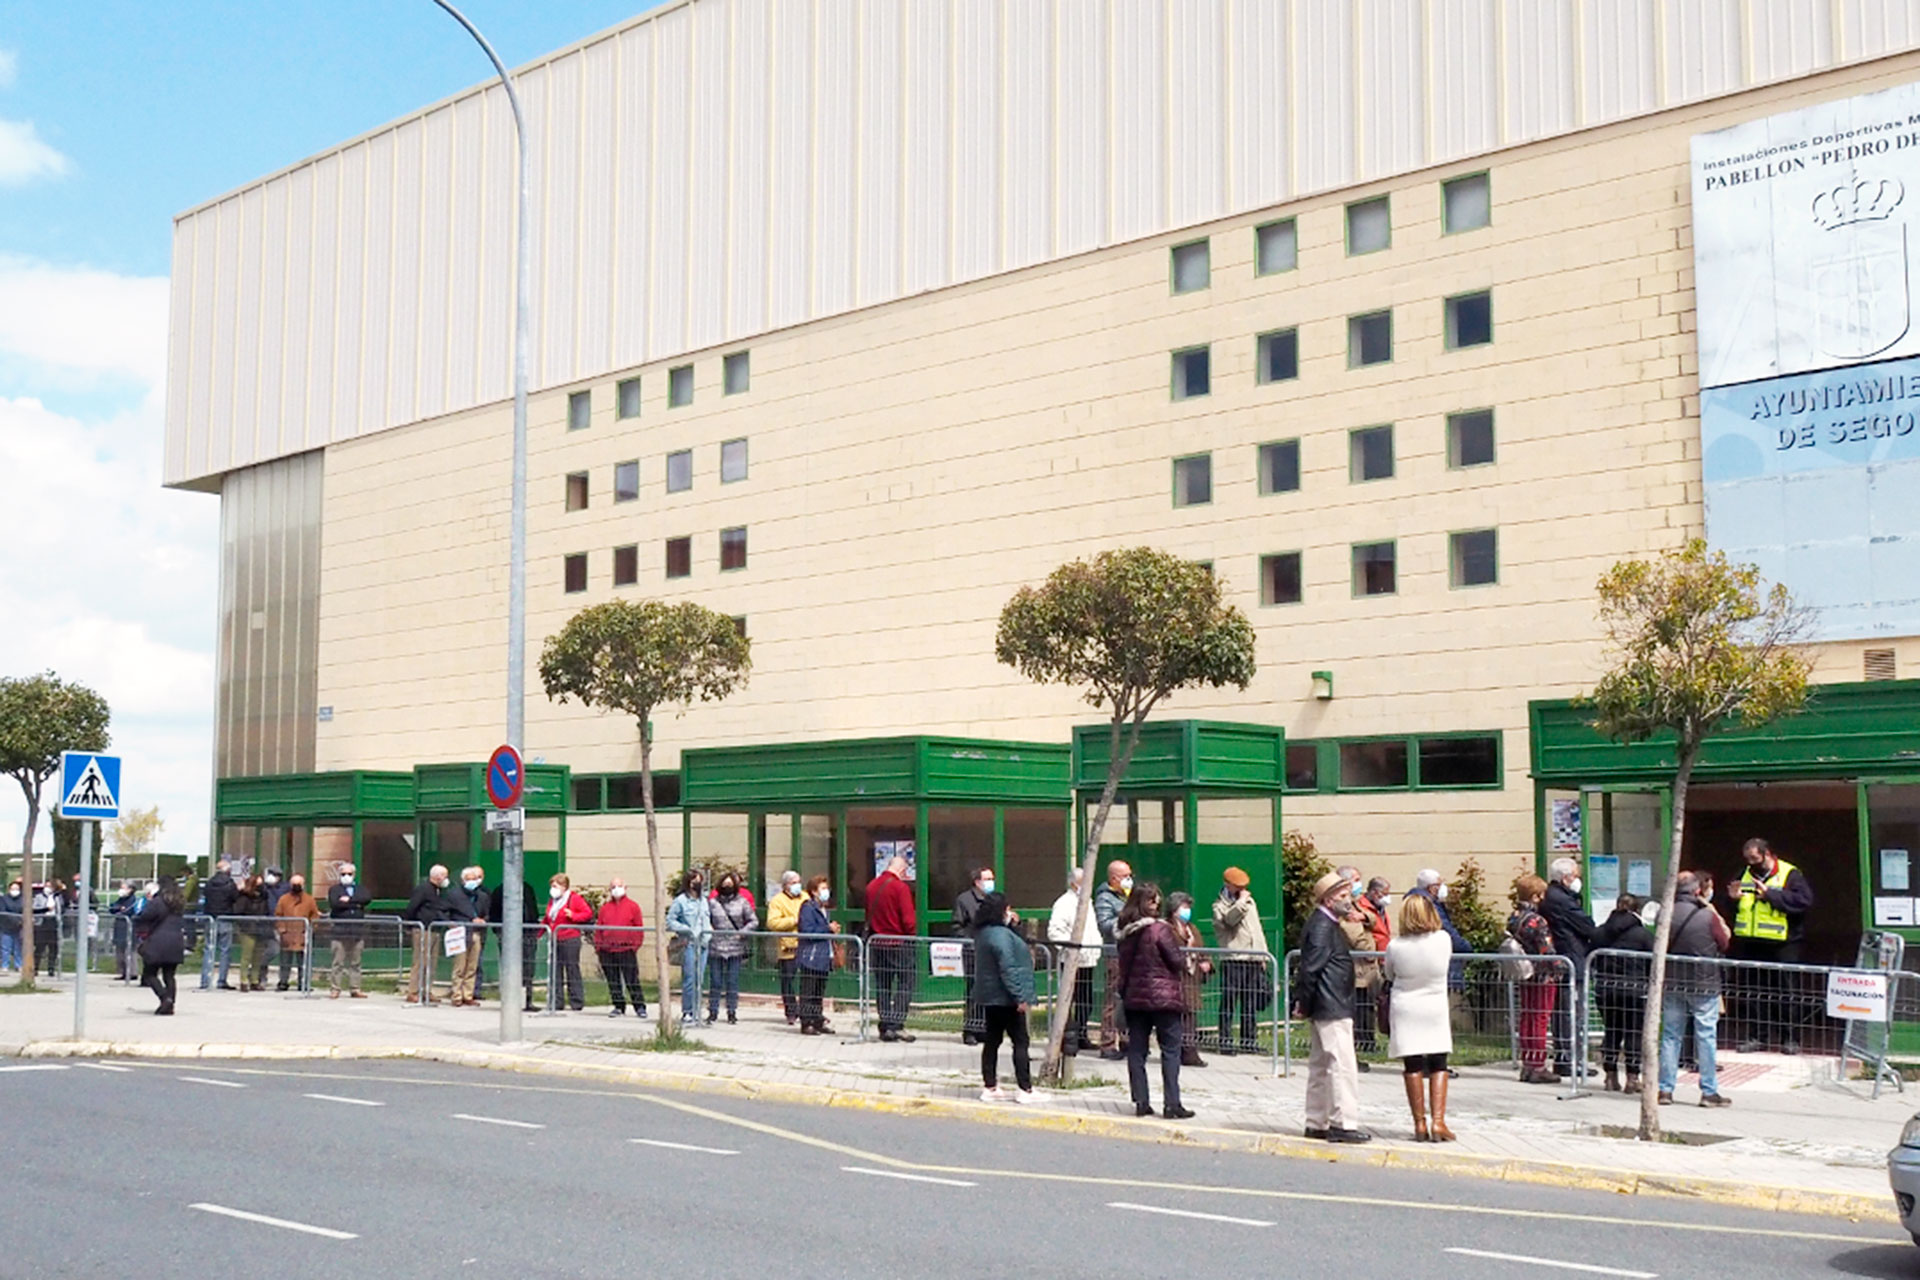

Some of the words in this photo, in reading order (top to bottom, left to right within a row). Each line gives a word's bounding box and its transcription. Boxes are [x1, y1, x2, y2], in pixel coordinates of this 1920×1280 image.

[1703, 141, 1808, 170] Instalaciones
[1812, 120, 1903, 146] Deportivas
[1705, 158, 1805, 191] PABELLON
[1750, 375, 1920, 420] AYUNTAMIE
[1776, 424, 1816, 450] DE
[1829, 413, 1915, 444] SEGO
[1837, 976, 1876, 986] ENTRADA
